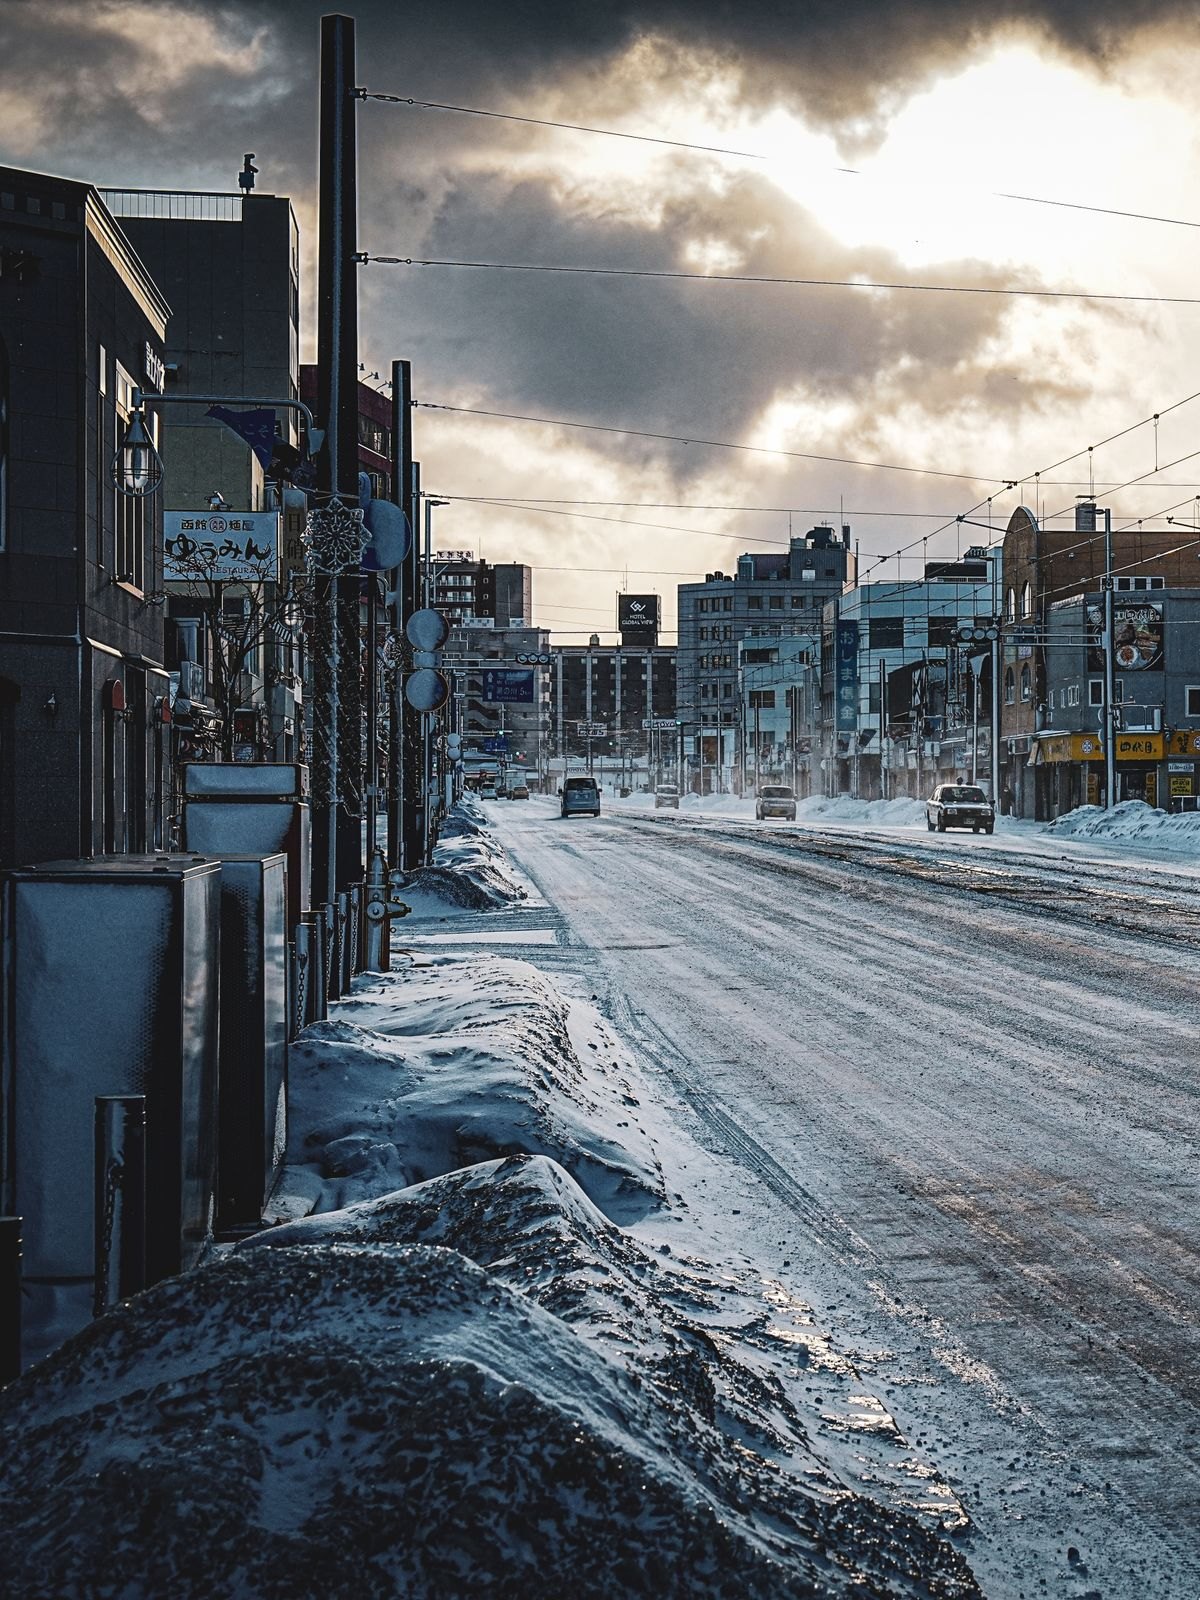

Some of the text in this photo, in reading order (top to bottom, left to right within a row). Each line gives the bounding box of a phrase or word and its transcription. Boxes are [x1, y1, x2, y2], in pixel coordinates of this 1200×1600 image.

[181, 519, 208, 531] 函館
[165, 533, 272, 561] ゆうみん
[840, 631, 856, 720] おしま信金
[1120, 741, 1153, 754] 四代目
